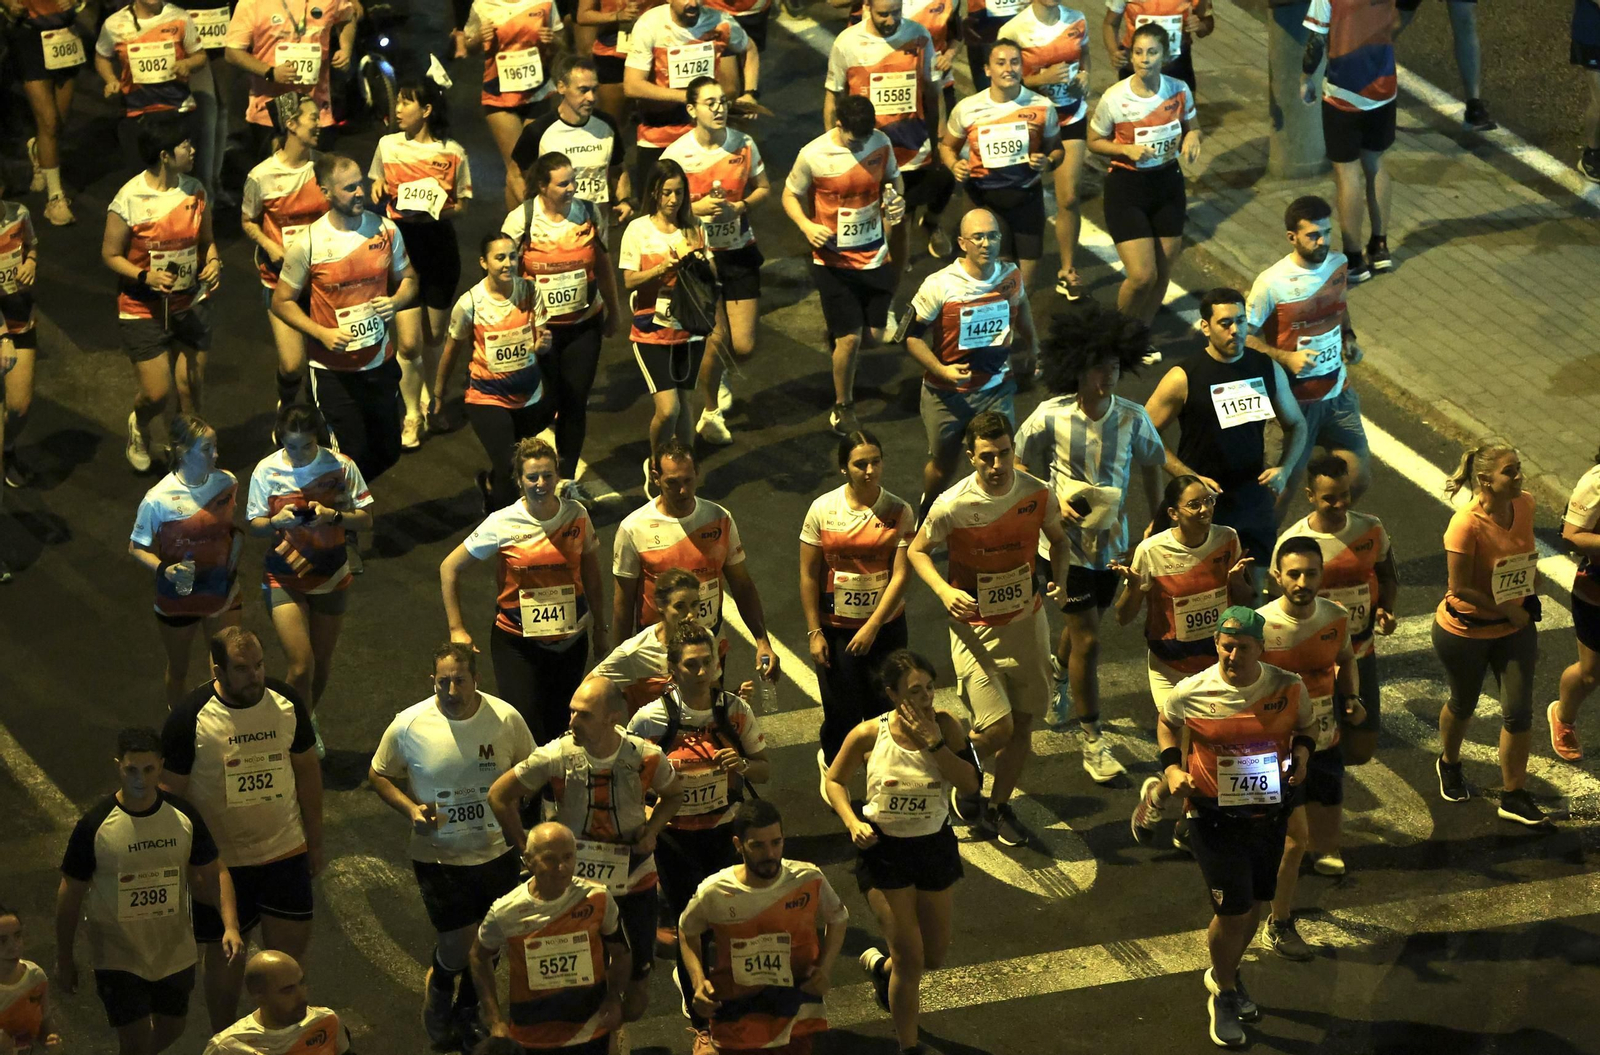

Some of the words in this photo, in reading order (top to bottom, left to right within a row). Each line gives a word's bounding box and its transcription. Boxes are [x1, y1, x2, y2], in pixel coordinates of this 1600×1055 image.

[52, 42, 77, 58] 3080
[139, 58, 167, 72] 3082
[504, 65, 536, 80] 19679
[675, 59, 709, 75] 14782
[876, 88, 911, 102] 15585
[565, 144, 603, 154] HITACHI
[986, 140, 1022, 156] 15589
[404, 187, 438, 205] 24081
[843, 219, 877, 236] 23770
[548, 288, 578, 304] 6067
[351, 317, 379, 337] 6046
[967, 319, 1003, 337] 14422
[496, 344, 527, 361] 6045
[1222, 397, 1261, 415] 11577
[1018, 504, 1034, 515] KH7
[701, 530, 719, 540] KH7
[1500, 571, 1526, 589] 7743
[845, 592, 878, 606] 2527
[989, 584, 1022, 604] 2895
[532, 606, 565, 623] 2441
[1186, 609, 1219, 628] 9969
[1263, 699, 1285, 711] KH7
[228, 731, 276, 745] HITACHI
[479, 744, 494, 759] M
[238, 773, 273, 792] 2352
[1230, 775, 1268, 792] 7478
[889, 797, 926, 811] 8754
[448, 804, 484, 823] 2880
[128, 838, 177, 853] HITACHI
[577, 862, 615, 879] 2877
[130, 889, 167, 907] 2398
[785, 897, 807, 910] KH7
[540, 955, 577, 976] 5527
[745, 955, 782, 972] 5144
